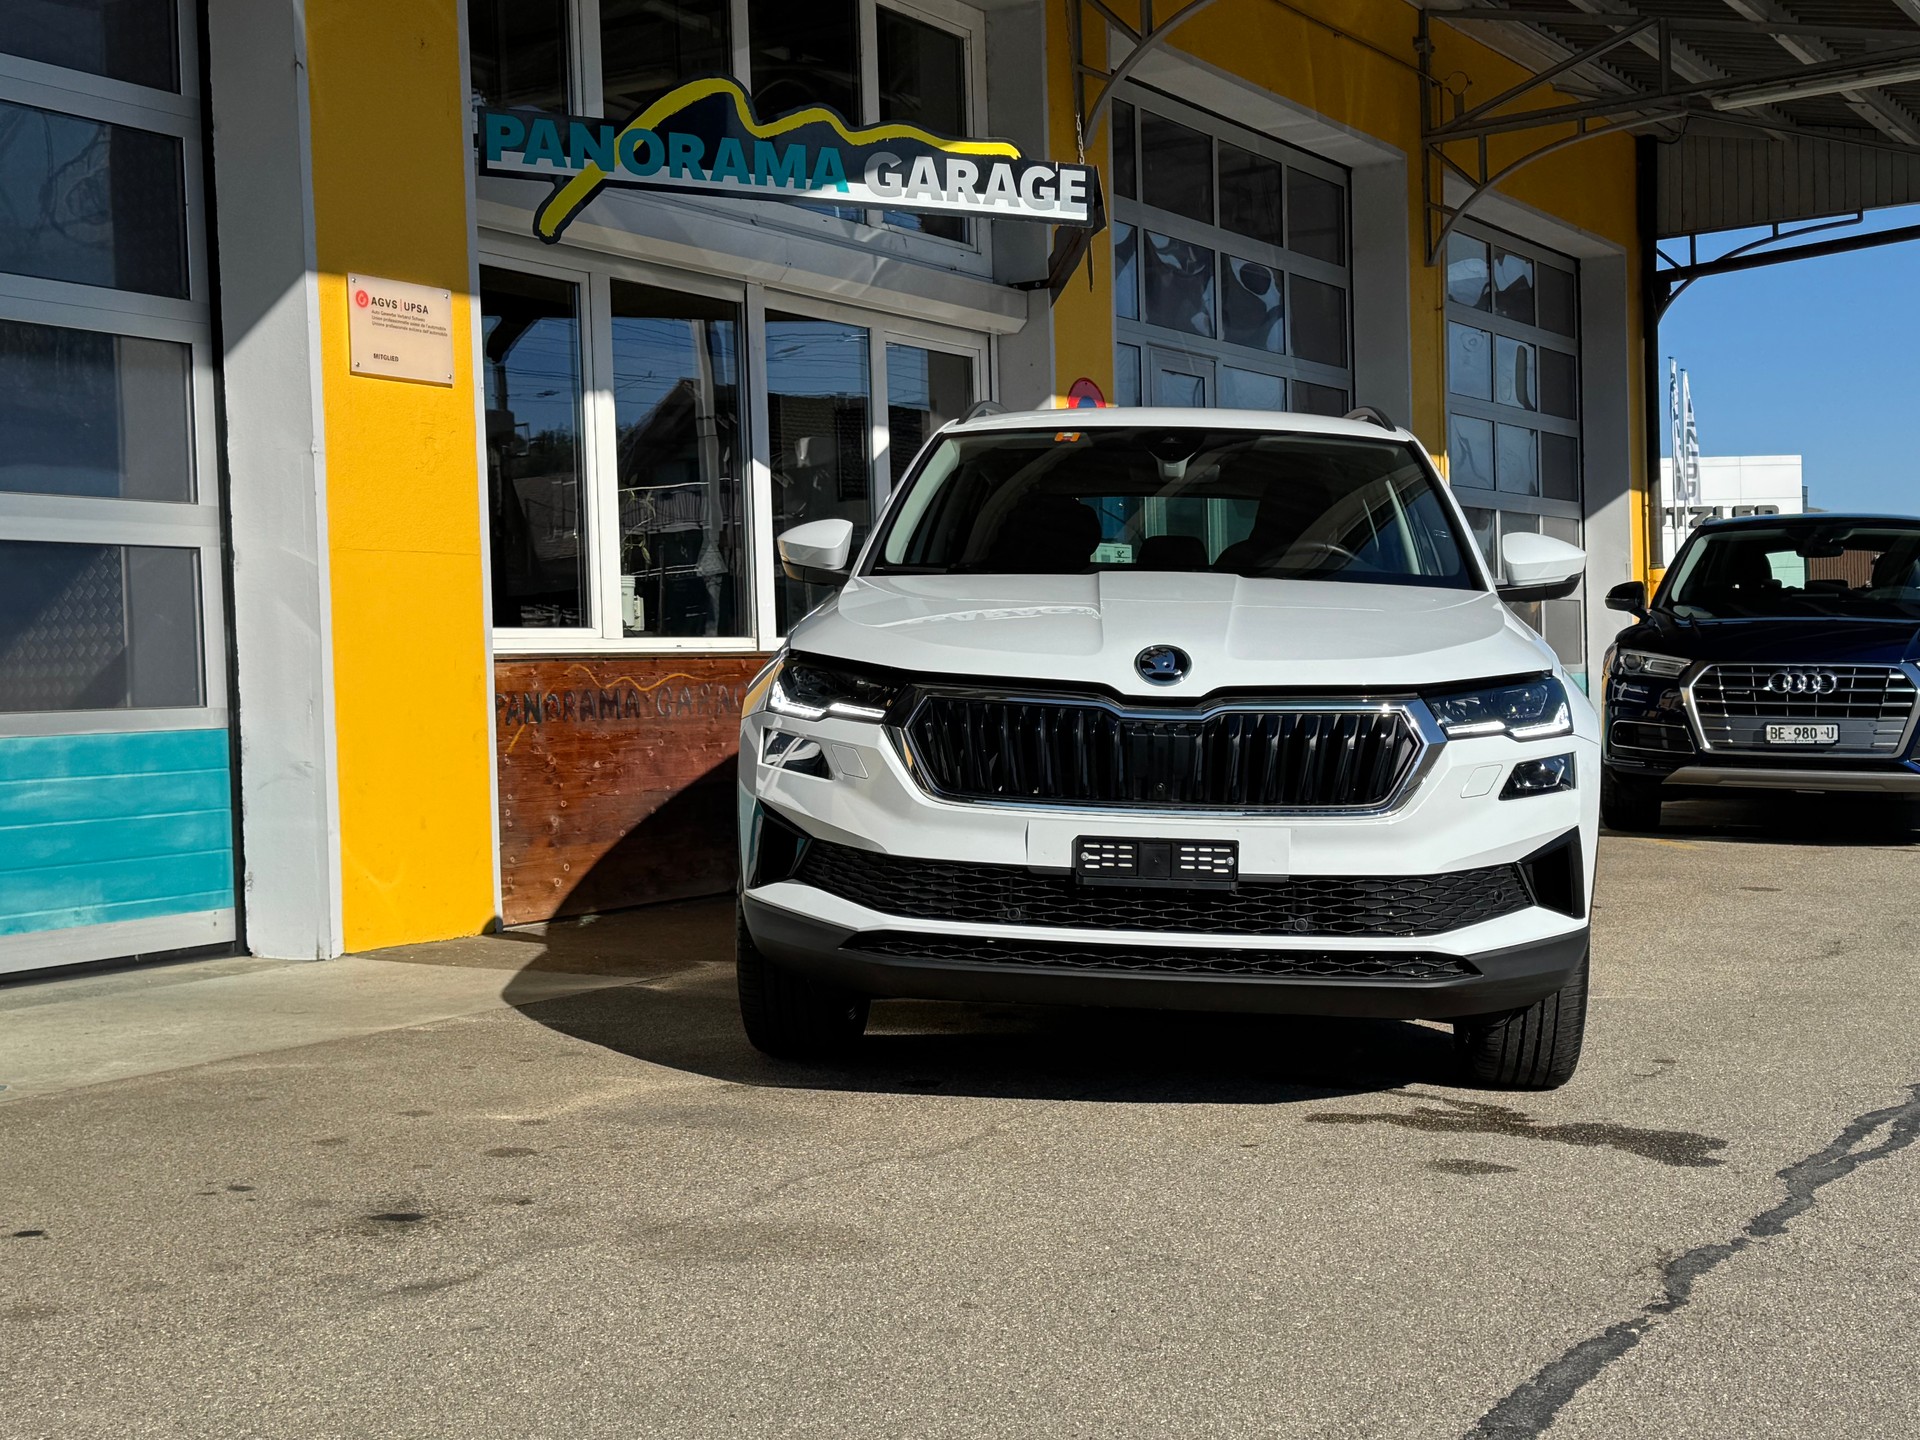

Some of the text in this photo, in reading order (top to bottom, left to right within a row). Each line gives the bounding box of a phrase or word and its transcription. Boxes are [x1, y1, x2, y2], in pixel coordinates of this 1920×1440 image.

[485, 112, 1088, 214] PANORAMA GARAGE
[371, 296, 429, 314] AGVS UPSA
[373, 353, 399, 362] MITGLIED
